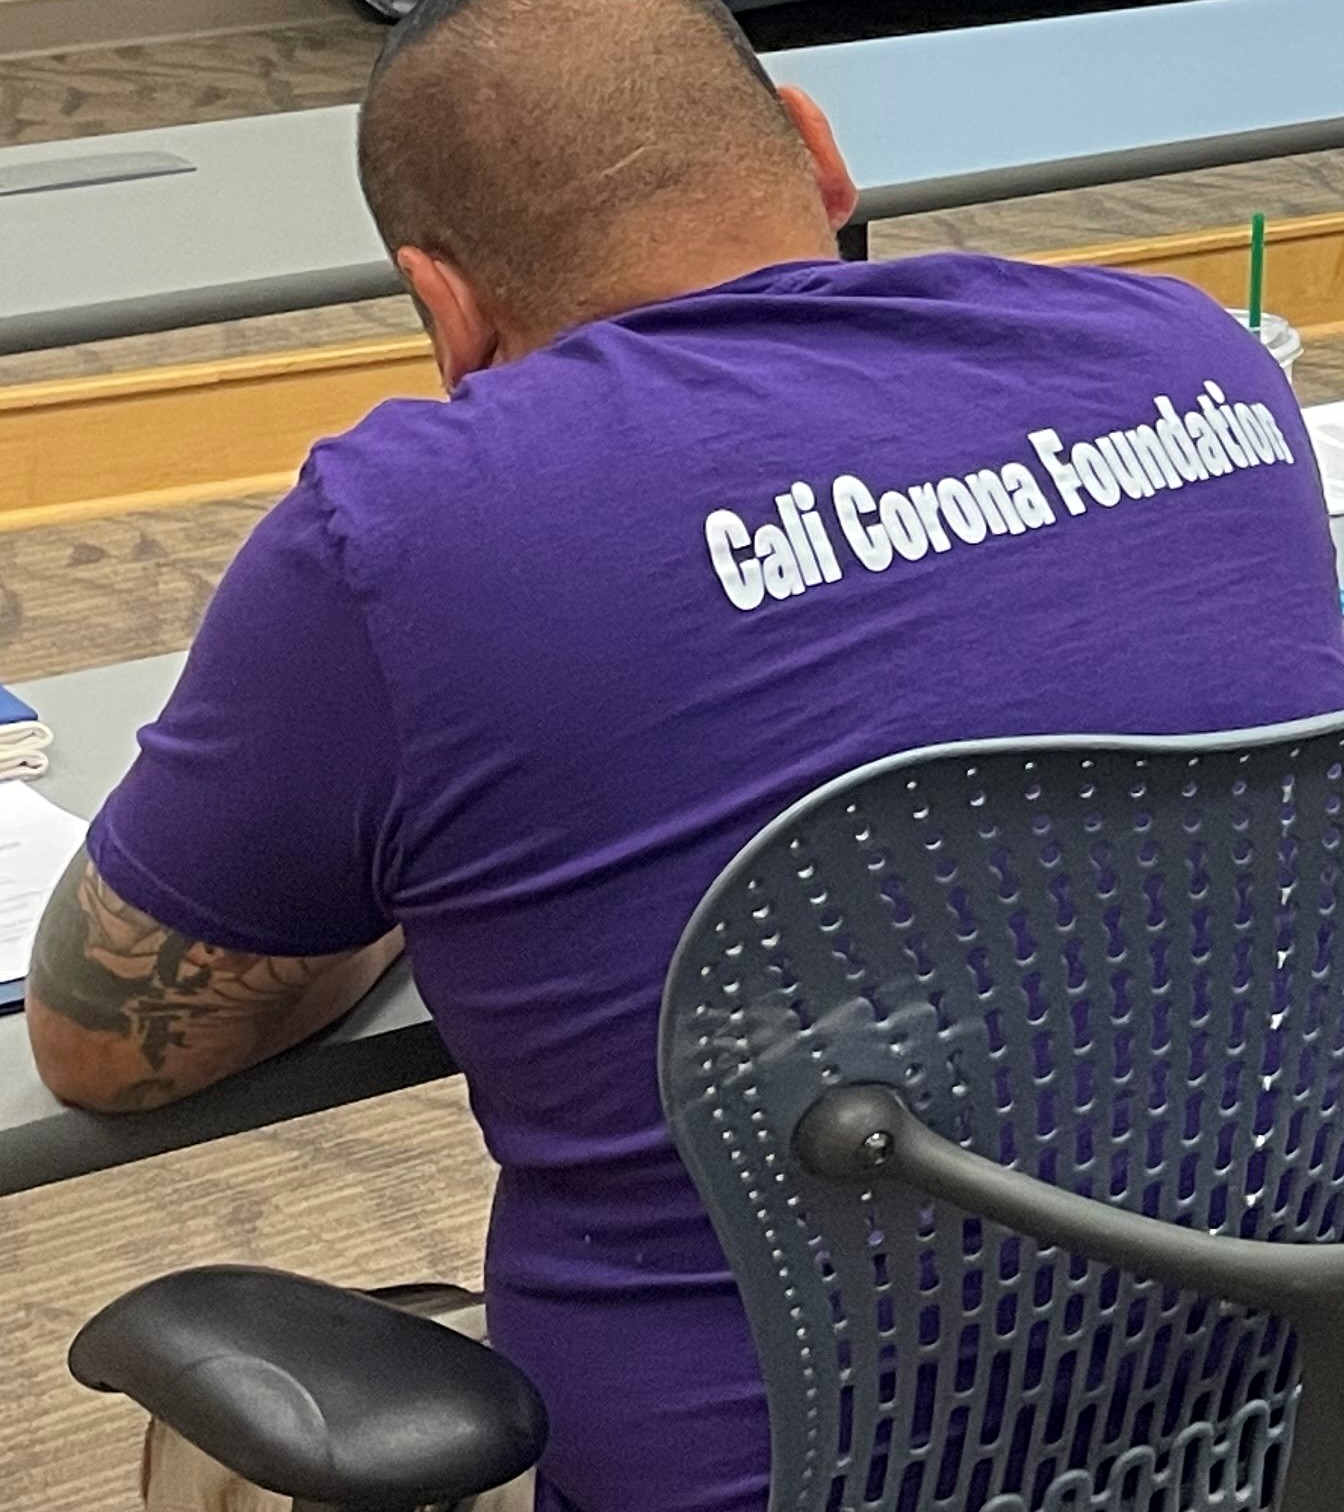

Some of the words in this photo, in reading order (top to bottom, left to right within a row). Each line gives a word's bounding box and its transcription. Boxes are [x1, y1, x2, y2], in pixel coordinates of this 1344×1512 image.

[704, 479, 844, 611] Cali
[831, 473, 1059, 573] Corona
[1027, 380, 1296, 517] Foundation
